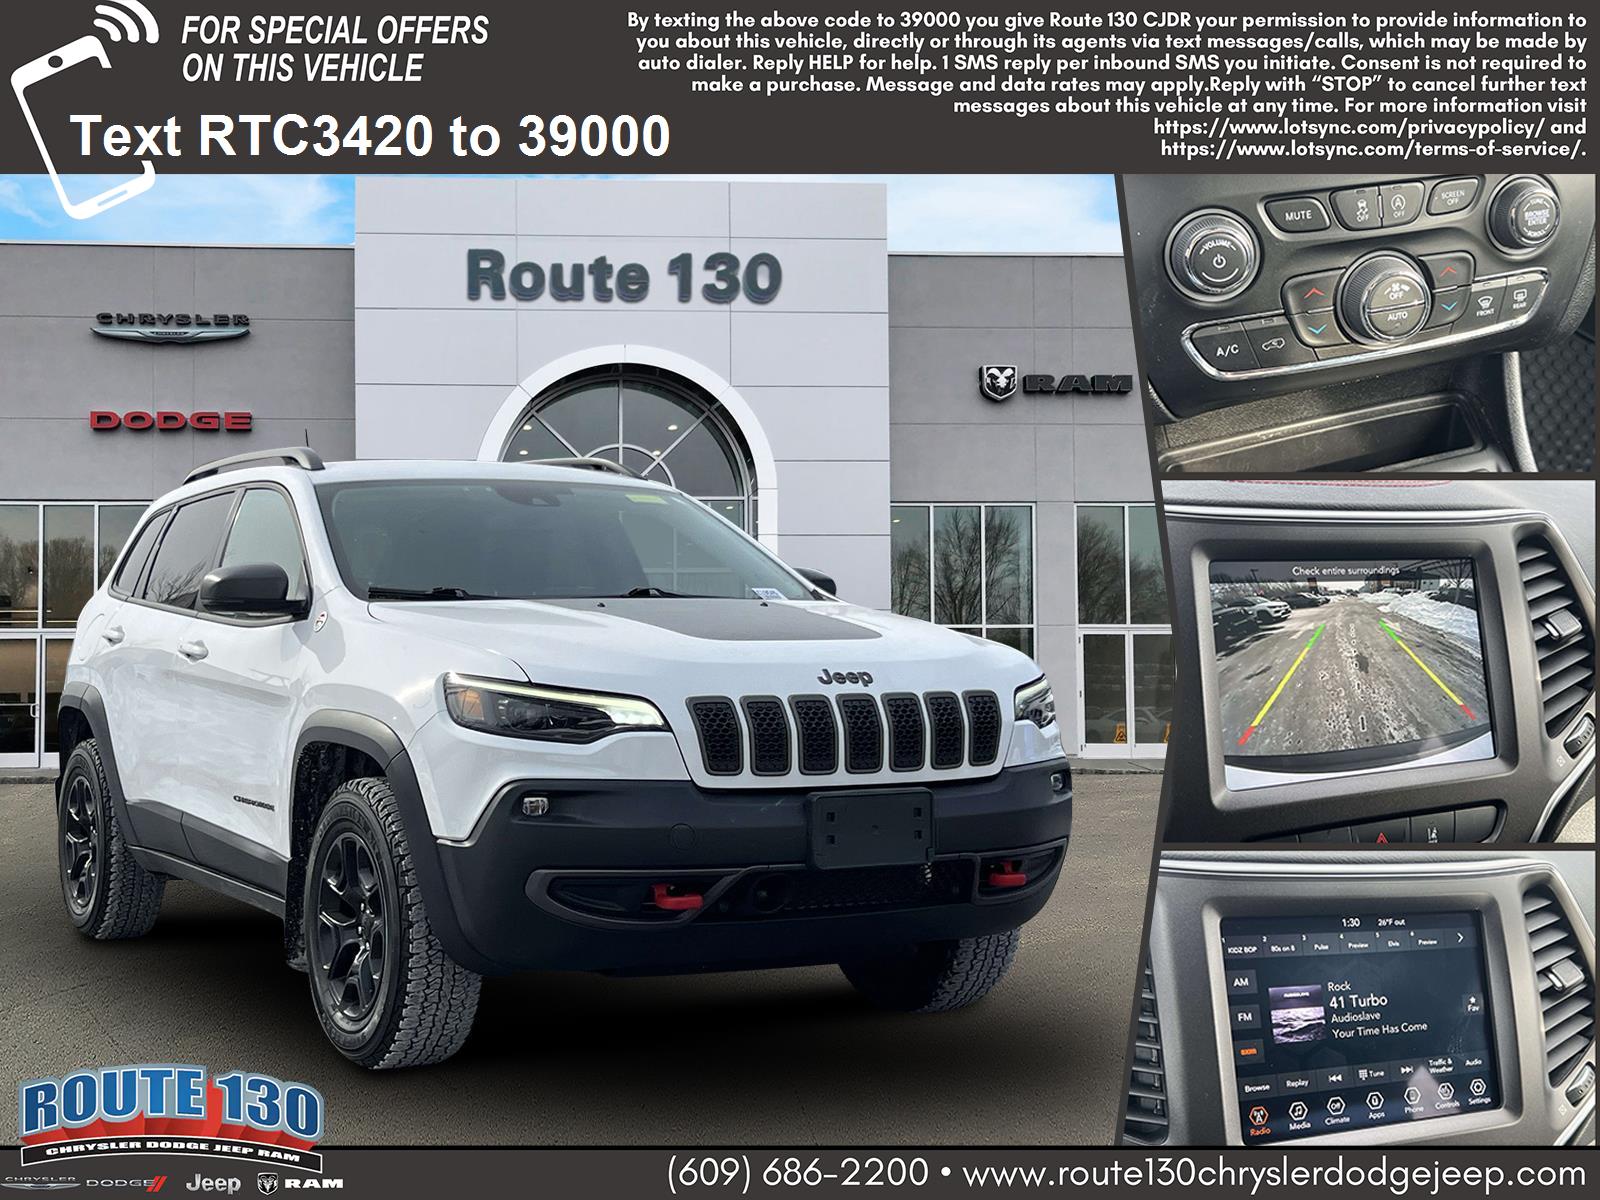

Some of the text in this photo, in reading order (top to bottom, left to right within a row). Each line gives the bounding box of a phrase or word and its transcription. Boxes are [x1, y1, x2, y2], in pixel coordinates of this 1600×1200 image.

[1441, 190, 1464, 198] SCREEN
[1446, 197, 1459, 205] OFF
[1285, 210, 1312, 221] MUTE
[1356, 213, 1369, 222] OFF
[1393, 209, 1405, 218] OFF
[1203, 239, 1232, 250] VOLUME
[467, 249, 782, 304] Route 130
[1389, 292, 1403, 300] OFF
[1387, 311, 1408, 321] AUTO
[1476, 308, 1495, 317] FRONT
[96, 312, 249, 326] CHRYSLER
[1216, 344, 1239, 357] A/C
[1023, 374, 1133, 394] RAM
[89, 410, 252, 431] DODGE
[1292, 565, 1400, 576] Check entire surroundings
[817, 669, 873, 687] Jeep
[1342, 918, 1360, 927] 1:30
[1233, 978, 1249, 987] AM
[1327, 981, 1351, 992] Rock
[1329, 993, 1388, 1009] 41 Turbo
[1467, 1004, 1480, 1012] Fav
[1238, 1013, 1252, 1021] FM
[1331, 1011, 1381, 1023] Audioslave
[1332, 1022, 1428, 1039] Your Time Has Come
[1429, 1059, 1446, 1067] Traffic
[1465, 1058, 1482, 1066] Audio
[1429, 1066, 1454, 1074] Weather
[1286, 1079, 1309, 1088] Replay
[1244, 1084, 1270, 1093] Browse
[1435, 1100, 1460, 1110] Controls
[1468, 1096, 1491, 1105] Settings
[1404, 1106, 1425, 1114] Phone
[1368, 1111, 1385, 1119] Apps
[1325, 1116, 1351, 1126] Climate
[1289, 1121, 1312, 1131] Media
[1250, 1127, 1272, 1136] Radio
